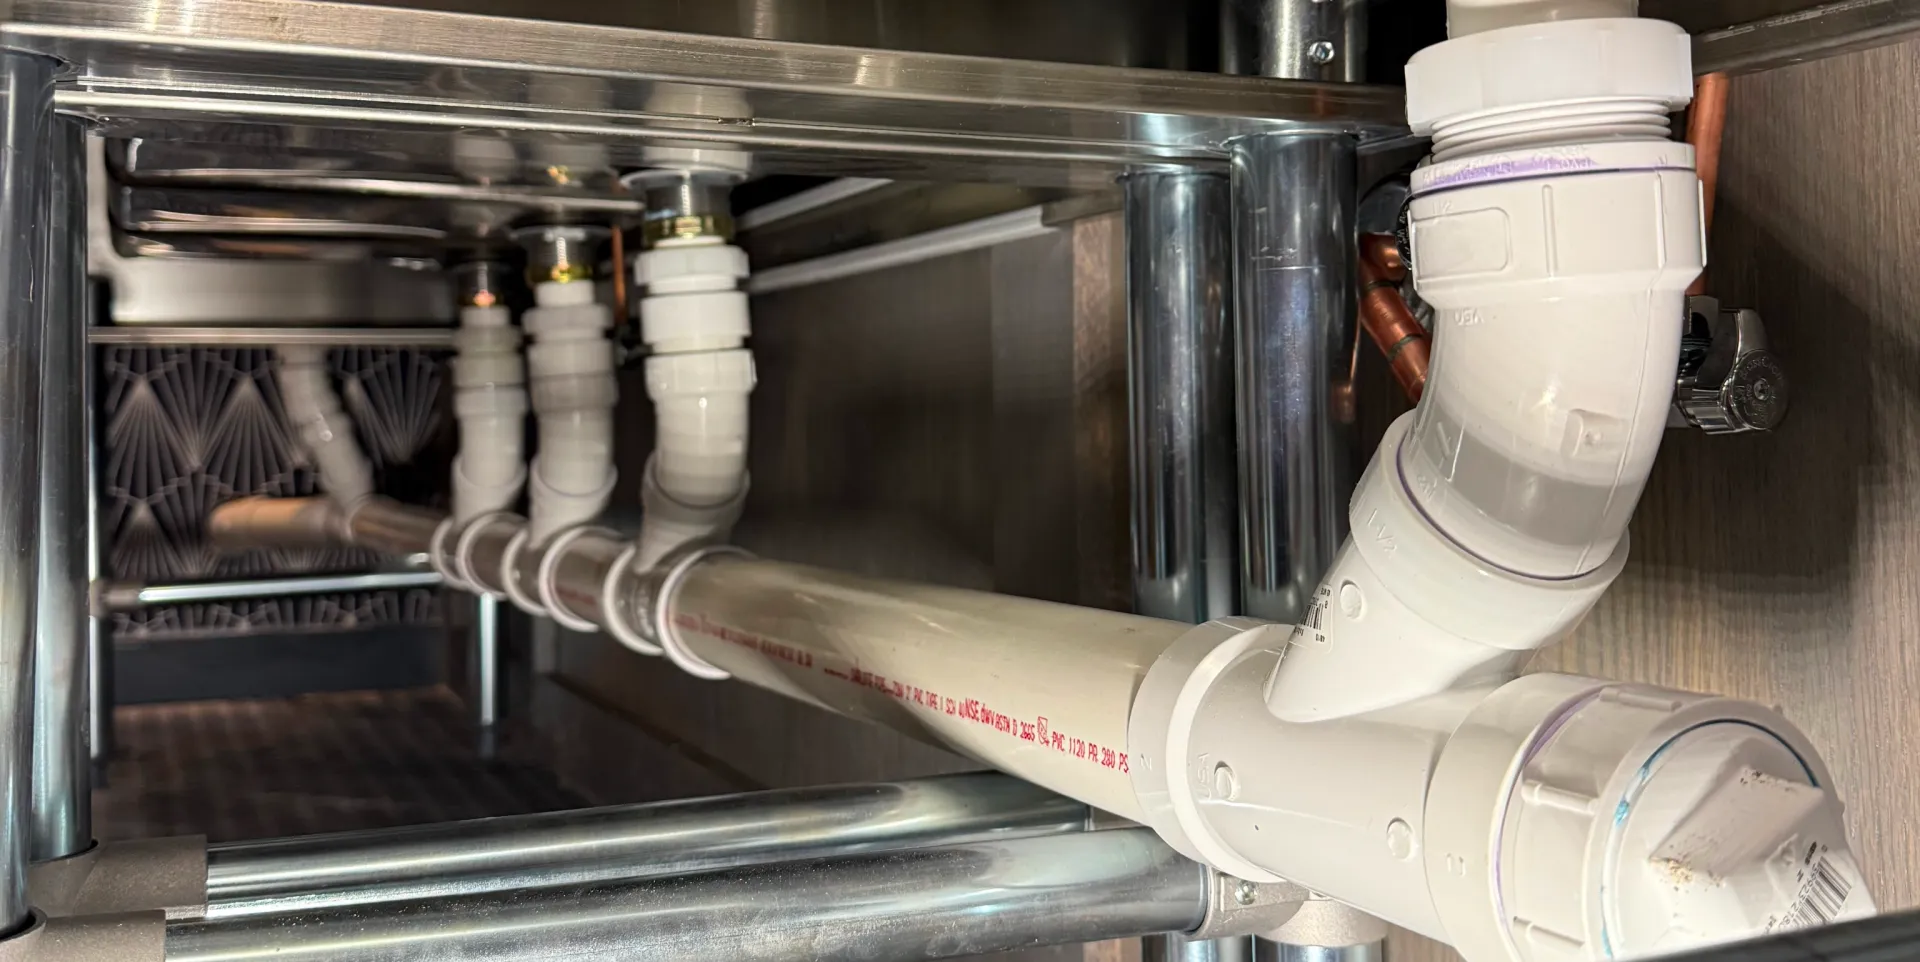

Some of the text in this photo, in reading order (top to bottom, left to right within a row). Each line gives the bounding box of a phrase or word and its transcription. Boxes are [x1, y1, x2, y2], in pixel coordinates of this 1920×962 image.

[1051, 731, 1065, 752] PVC
[1068, 736, 1086, 759] 1120
[1088, 742, 1098, 763] PR
[1101, 746, 1116, 770] 280
